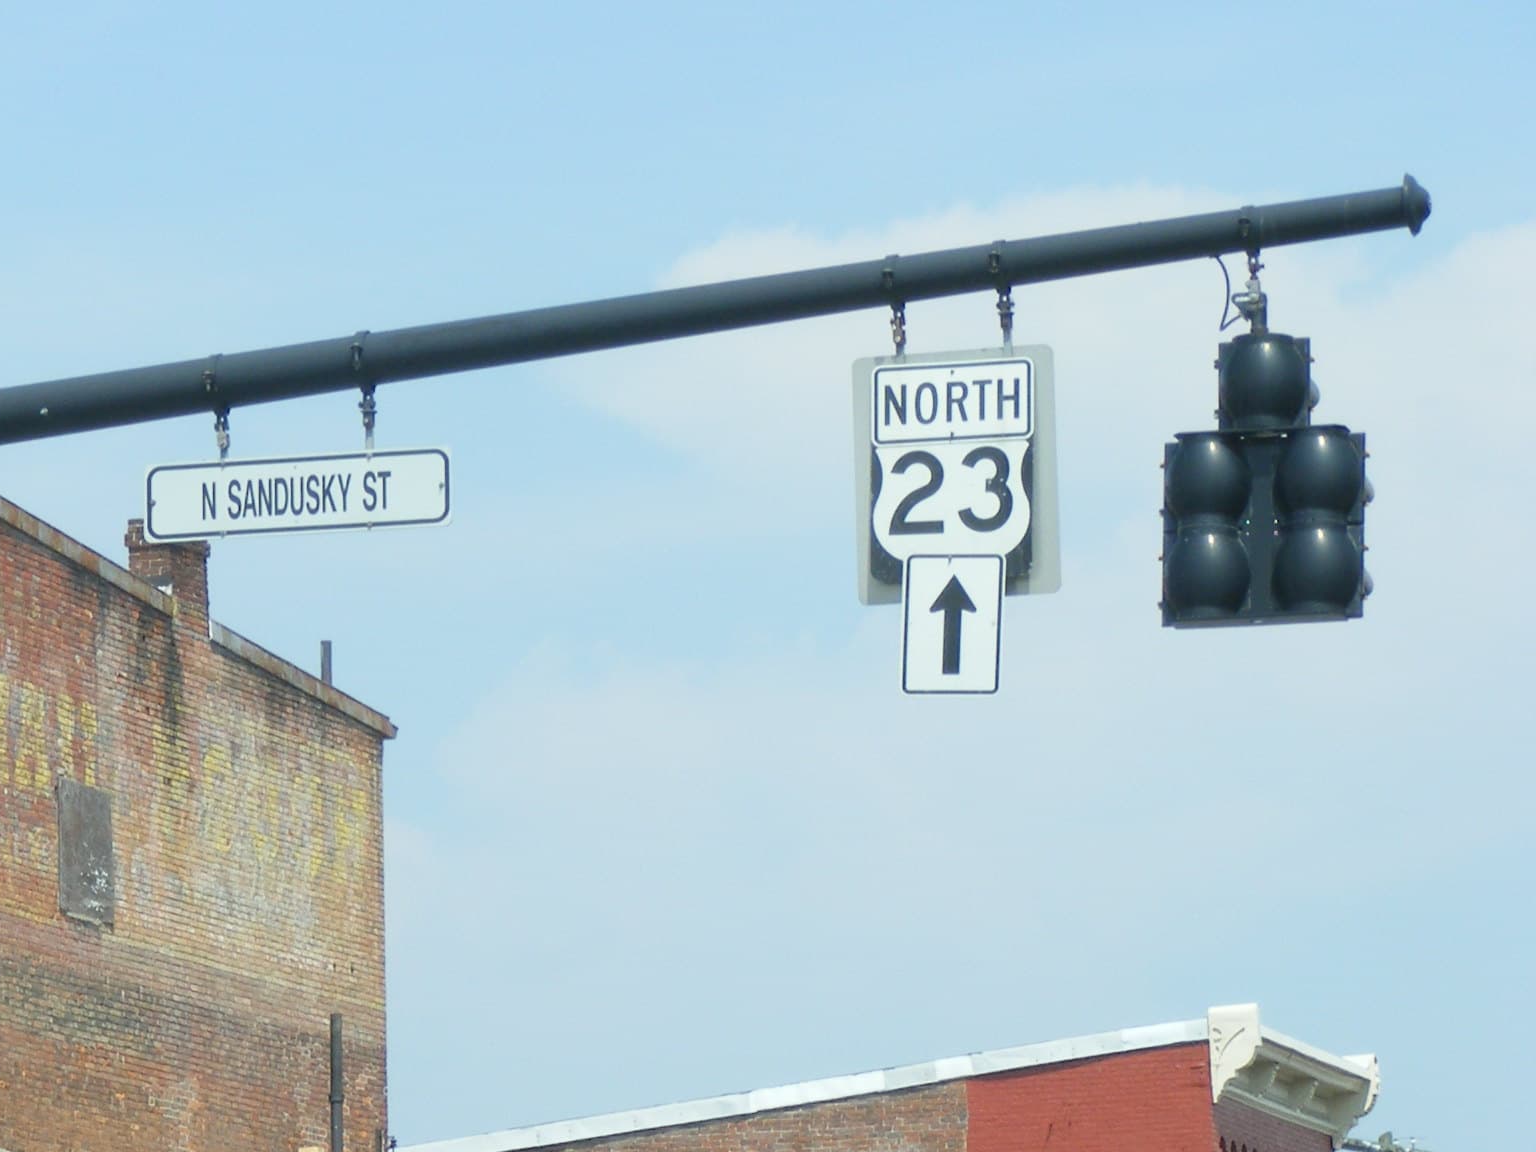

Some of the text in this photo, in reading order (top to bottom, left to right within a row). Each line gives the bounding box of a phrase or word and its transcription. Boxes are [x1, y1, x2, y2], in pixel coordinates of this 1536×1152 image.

[883, 377, 1021, 427] NORTH
[202, 471, 392, 520] N SANDUSKY ST
[888, 446, 1014, 536] 23
